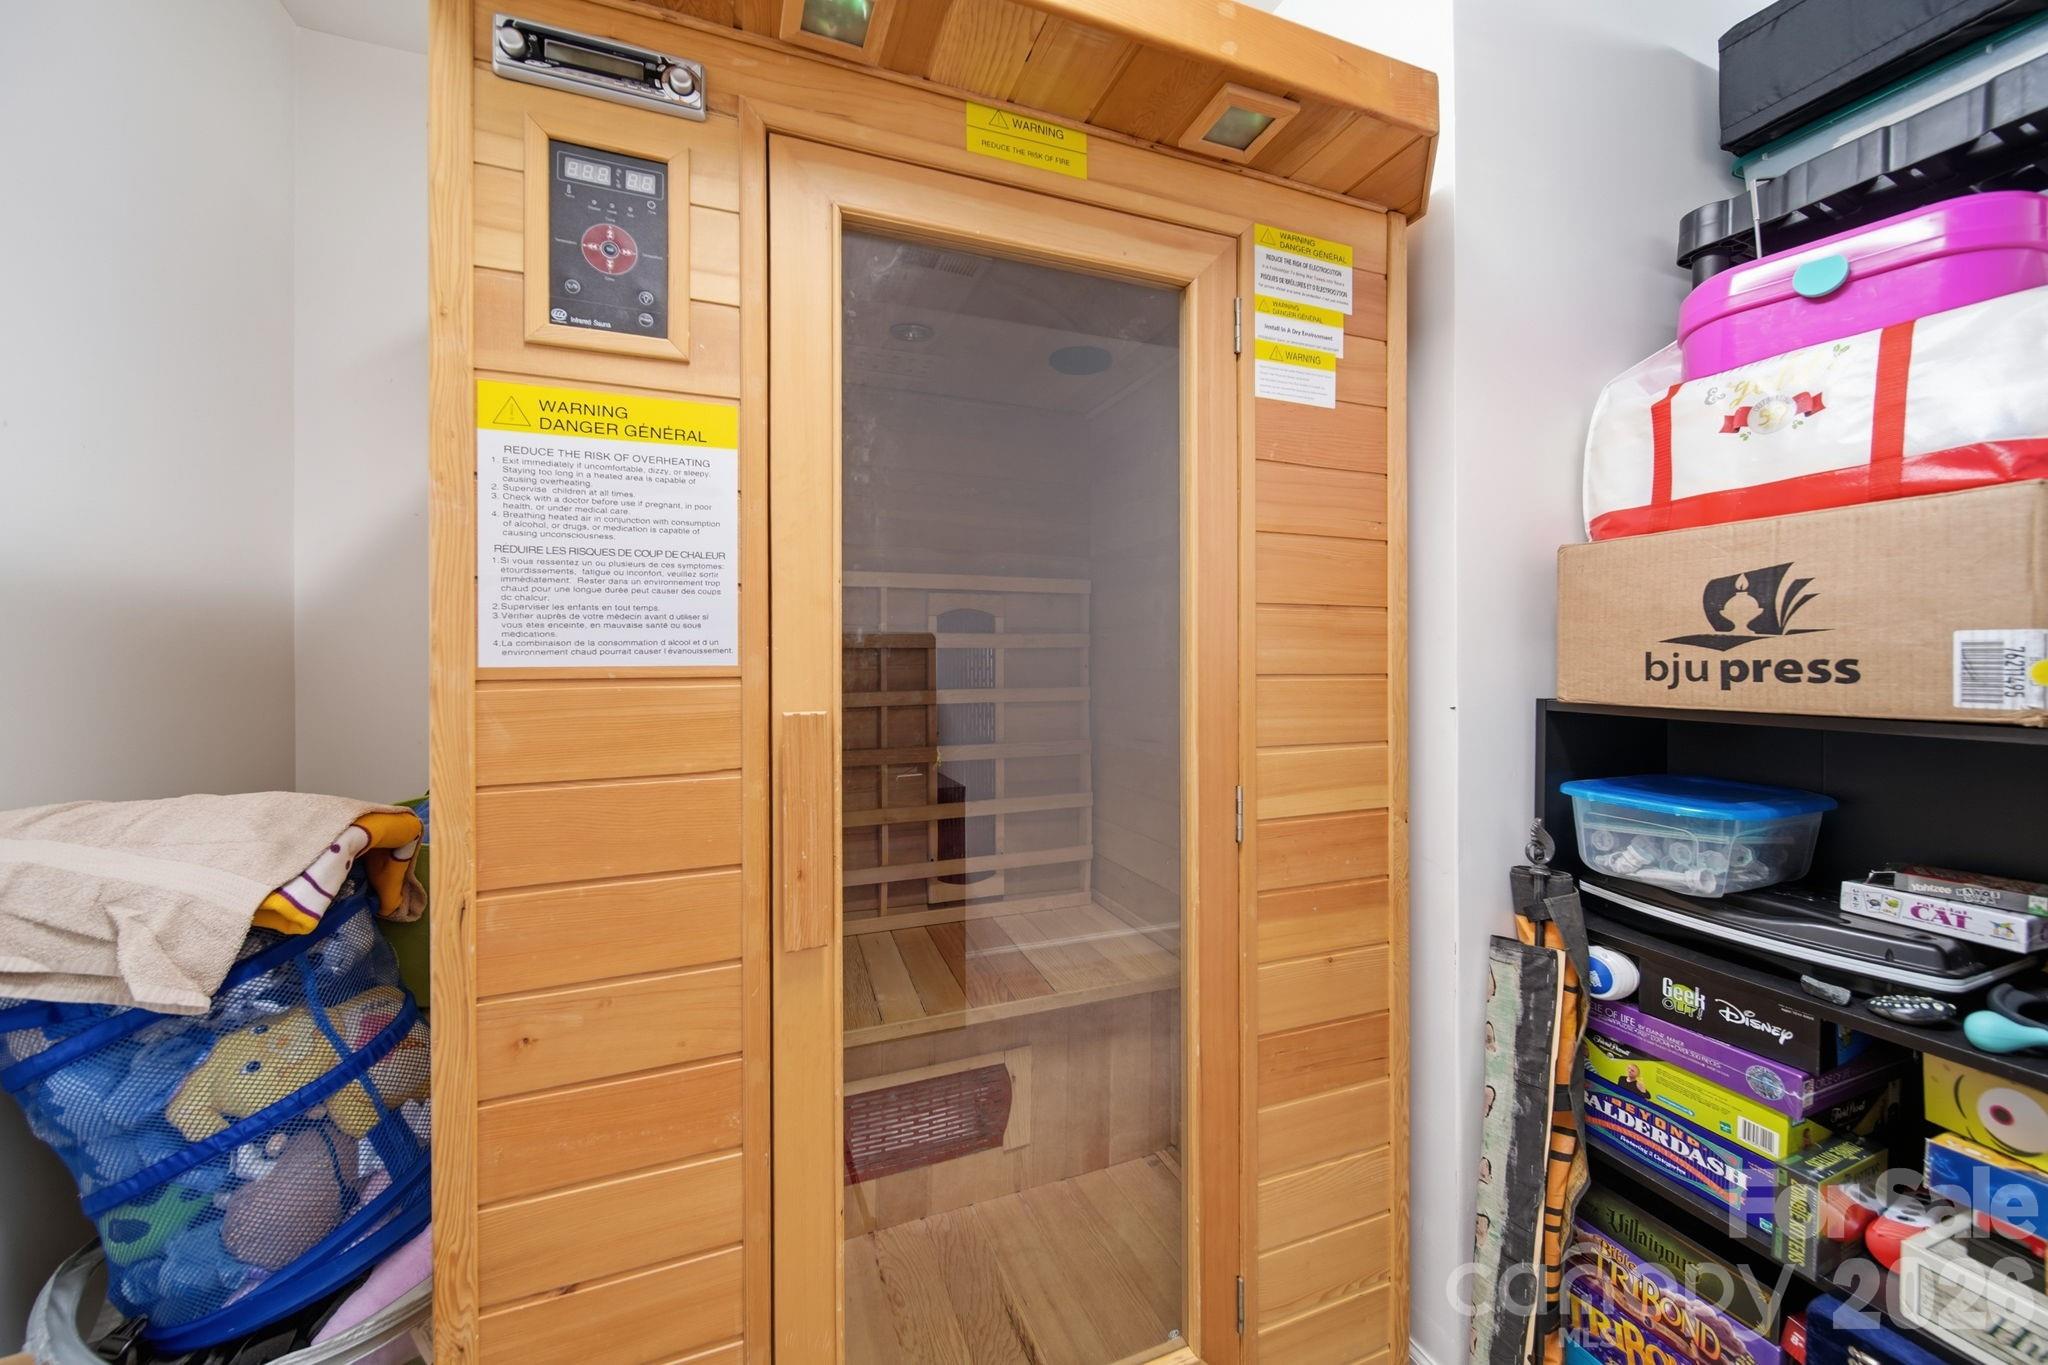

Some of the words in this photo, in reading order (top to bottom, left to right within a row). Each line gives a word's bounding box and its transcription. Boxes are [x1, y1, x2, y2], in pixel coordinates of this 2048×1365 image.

[1012, 118, 1064, 140] WARNING
[981, 140, 1011, 152] REDUCE
[1012, 146, 1026, 156] THE
[1045, 154, 1054, 162] OF
[1056, 157, 1070, 166] FIRE
[1280, 232, 1316, 247] WARNING
[1280, 242, 1312, 256] DANGER
[1286, 351, 1321, 364] WARNING
[539, 400, 628, 420] WARNING
[540, 418, 619, 436] DANGER
[624, 423, 707, 443] GÉNÉRAL
[504, 445, 554, 456] REDUCE
[558, 449, 580, 458] THE
[584, 451, 610, 460] RISK
[614, 453, 630, 462] OF
[632, 454, 710, 468] OVERHEATING
[522, 458, 574, 470] immediately
[502, 466, 535, 476] Staying
[555, 469, 573, 479] long
[594, 472, 622, 480] heated
[655, 476, 686, 484] capable
[502, 476, 537, 485] causing
[503, 484, 546, 493] Supervise
[552, 487, 586, 495] children
[503, 493, 530, 501] Check
[562, 496, 588, 504] doctor
[592, 498, 618, 506] before
[503, 511, 545, 521] Breathing
[549, 513, 578, 521] heated
[604, 516, 650, 524] conjunction
[671, 519, 720, 528] consumption
[503, 529, 537, 538] causing
[604, 524, 647, 532] medication
[659, 527, 690, 535] capable
[546, 546, 566, 555] LES
[568, 547, 616, 556] RISQUES
[618, 549, 632, 557] DE
[634, 550, 663, 558] COUP
[680, 551, 726, 560] CHALEUR
[609, 560, 645, 568] plusieurs
[583, 568, 610, 577] fatigue
[573, 586, 601, 594] longue
[631, 587, 649, 595] peut
[705, 579, 720, 588] trop
[501, 603, 549, 612] Superviser
[600, 647, 631, 656] pourrait
[1645, 652, 1709, 690] bju
[1720, 655, 1862, 691] press
[1911, 884, 1952, 894] Yahtzee
[1910, 906, 1971, 929] CAT
[1662, 977, 1706, 1011] Geek
[1605, 1008, 1618, 1018] OF
[1620, 1014, 1636, 1026] LIFE
[1612, 1098, 1700, 1148] BEYOND
[1600, 1237, 1639, 1272] Bible
